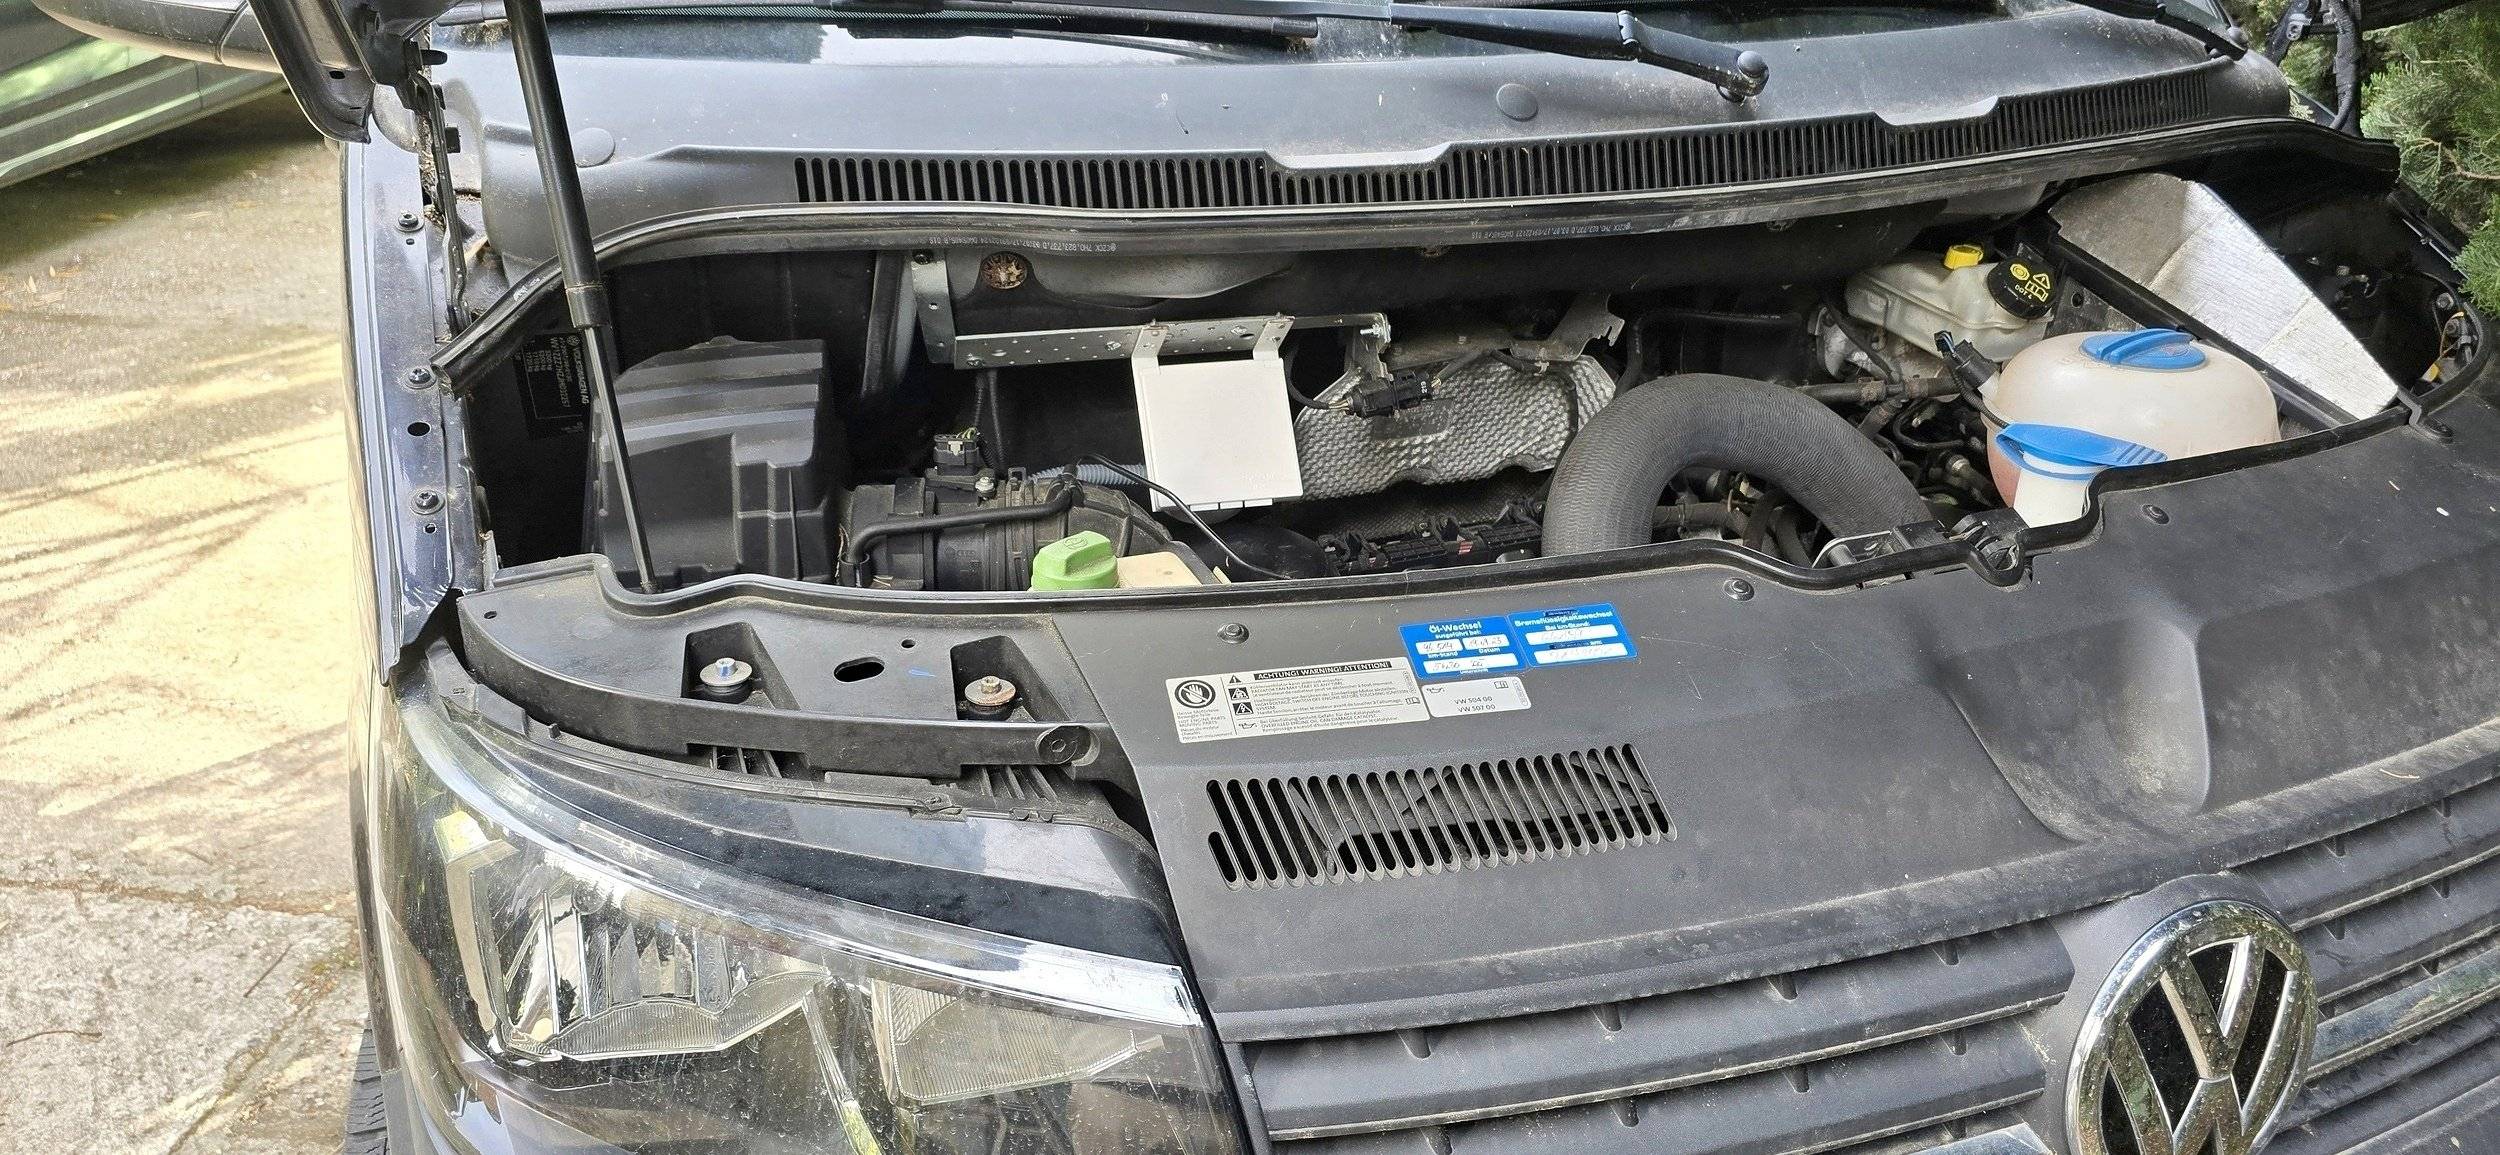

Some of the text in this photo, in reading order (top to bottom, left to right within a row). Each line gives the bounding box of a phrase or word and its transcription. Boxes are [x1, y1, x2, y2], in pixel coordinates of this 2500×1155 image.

[2015, 284, 2028, 296] DOT
[1428, 620, 1482, 634] Öl-Wechsel
[1258, 661, 1390, 680] ACHTUNG! WARNING! ATTENTION!
[1454, 697, 1467, 705] VW
[1468, 696, 1482, 704] 504
[1457, 705, 1471, 713] VW
[1471, 704, 1485, 712] 507
[2085, 915, 2310, 1155] VW
